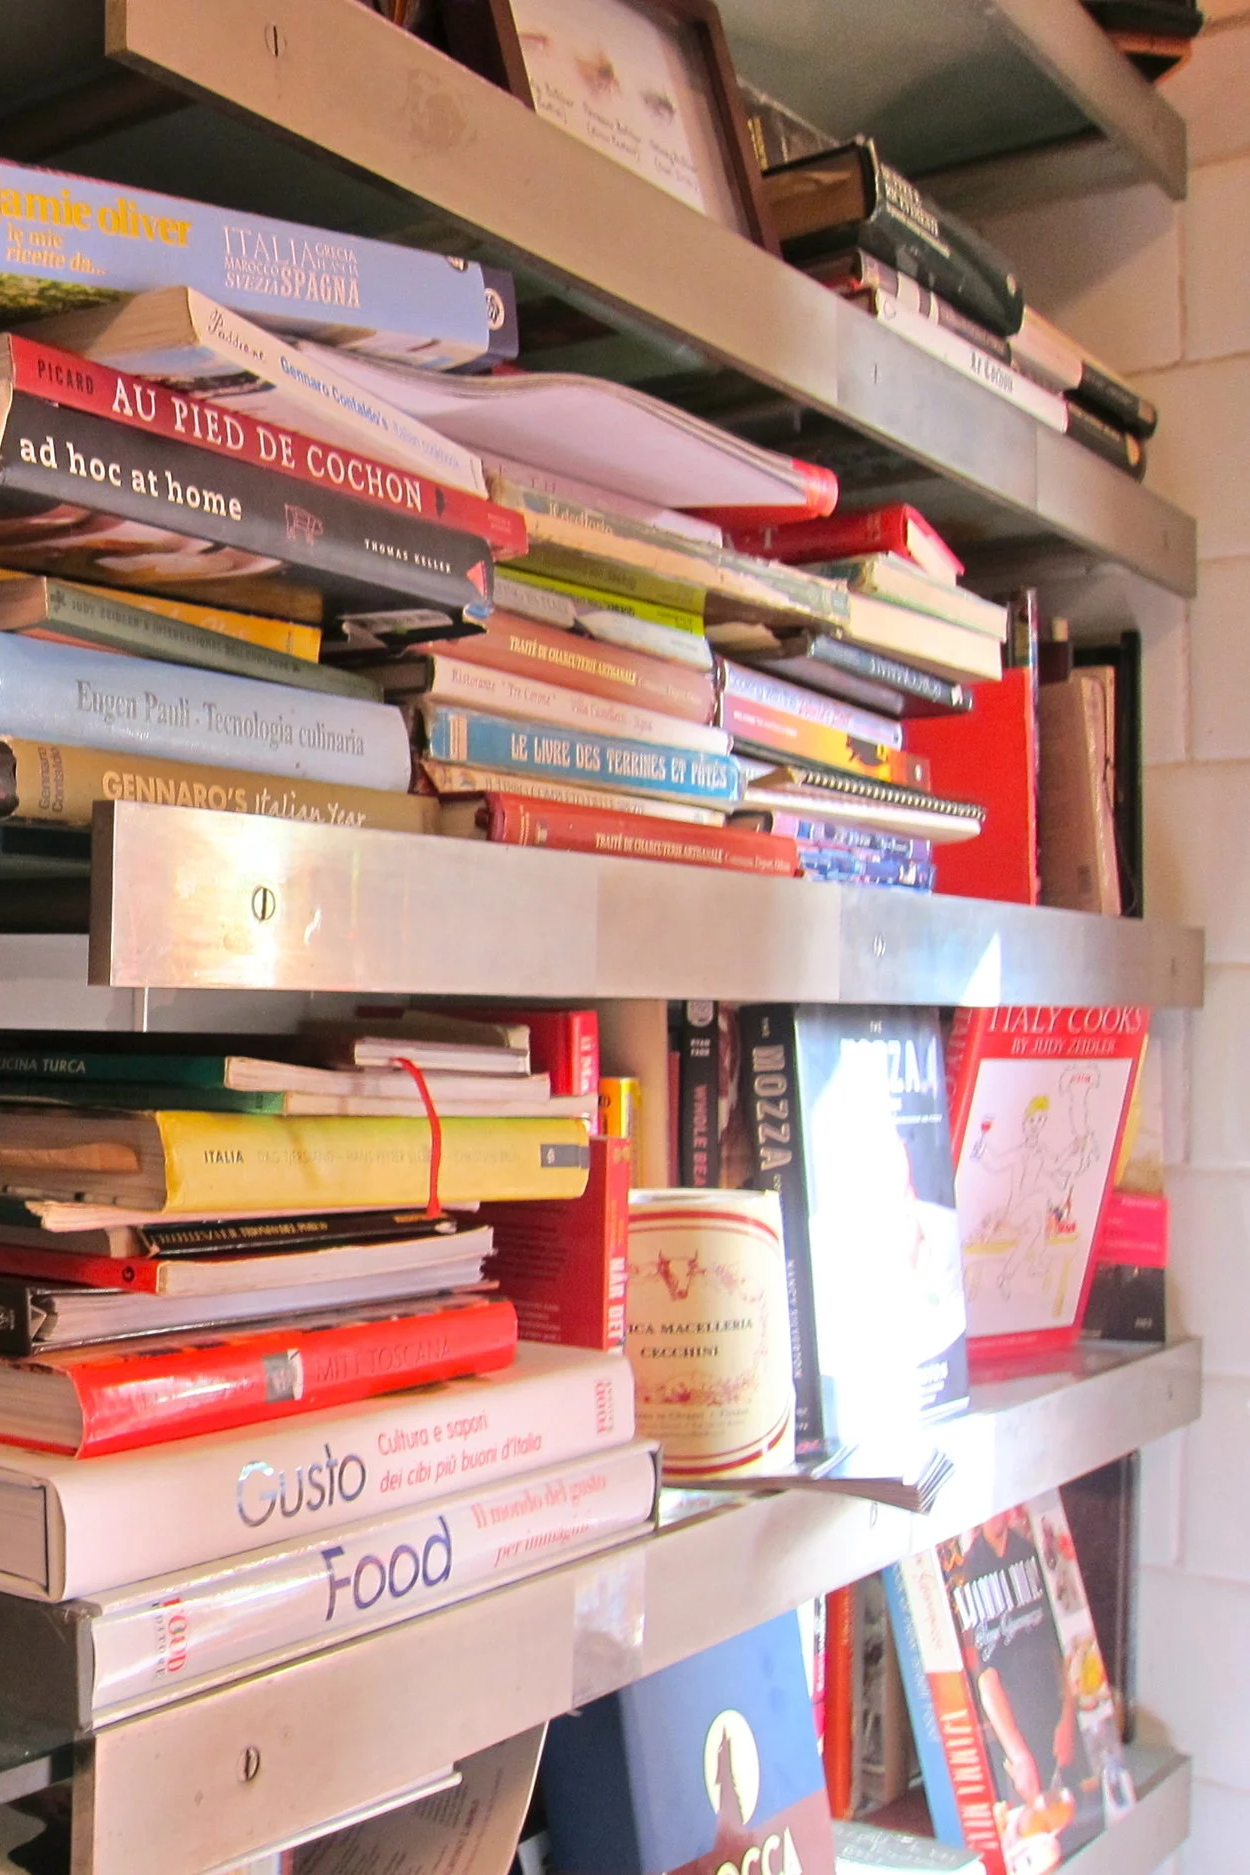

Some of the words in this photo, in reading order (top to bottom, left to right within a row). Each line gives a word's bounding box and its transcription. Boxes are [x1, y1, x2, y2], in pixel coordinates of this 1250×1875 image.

[97, 198, 193, 247] oliver
[5, 244, 65, 270] ricette
[224, 225, 316, 270] ITALIA
[224, 255, 279, 279] MAROCCO
[316, 241, 358, 265] GRECIA
[225, 272, 279, 296] SVEZIA
[280, 269, 361, 308] SPAGNA
[280, 356, 330, 397] Gennaro
[332, 387, 390, 431] Contaldo's
[37, 358, 95, 395] PICARD
[112, 378, 157, 421] AU
[171, 395, 246, 453] PIED
[258, 426, 298, 470] DE
[305, 444, 422, 513] COCHON
[19, 432, 58, 469] ad
[68, 444, 123, 487] hoc
[131, 464, 161, 495] at
[167, 473, 242, 521] home
[364, 538, 408, 561] THOMAS
[414, 552, 451, 574] KELLER
[76, 679, 136, 722] Eugen
[144, 691, 190, 727] Pauli
[202, 701, 293, 750] Tecnologia
[298, 721, 364, 756] culinaria
[38, 746, 50, 811] Gennaro
[50, 746, 64, 813] Contaldo
[511, 734, 528, 760] LE
[535, 737, 570, 768] LIVRE
[575, 743, 601, 770] DES
[607, 747, 667, 781] TERRINES
[671, 758, 687, 787] ET
[102, 770, 246, 812] GENNARO'S
[254, 788, 321, 822] Italian
[328, 802, 366, 828] Year
[989, 1006, 1058, 1034] ITALY
[1068, 1007, 1142, 1033] COOKS
[43, 1058, 87, 1073] TURCA
[1011, 1038, 1027, 1054] BY
[1034, 1038, 1063, 1055] JUDY
[693, 1084, 707, 1148] WHOLE
[753, 1044, 792, 1171] MOZZA
[204, 1149, 244, 1164] ITALIA
[693, 1151, 707, 1187] BEA
[661, 1318, 754, 1336] MACELLERIA
[367, 1343, 452, 1378] TOSCANA
[640, 1346, 719, 1360] CECCHINI
[378, 1425, 430, 1457] Cultura
[433, 1427, 444, 1442] e
[446, 1409, 489, 1443] sapori
[379, 1469, 404, 1493] dei
[407, 1460, 431, 1486] cibi
[433, 1453, 458, 1484] più
[461, 1441, 498, 1474] buoni
[501, 1430, 542, 1462] d'Italia
[237, 1443, 366, 1529] Gusto
[470, 1503, 487, 1530] Il
[489, 1489, 543, 1525] mondo
[545, 1480, 570, 1508] del
[571, 1473, 608, 1505] gusto
[320, 1515, 451, 1621] Food
[494, 1538, 522, 1568] per
